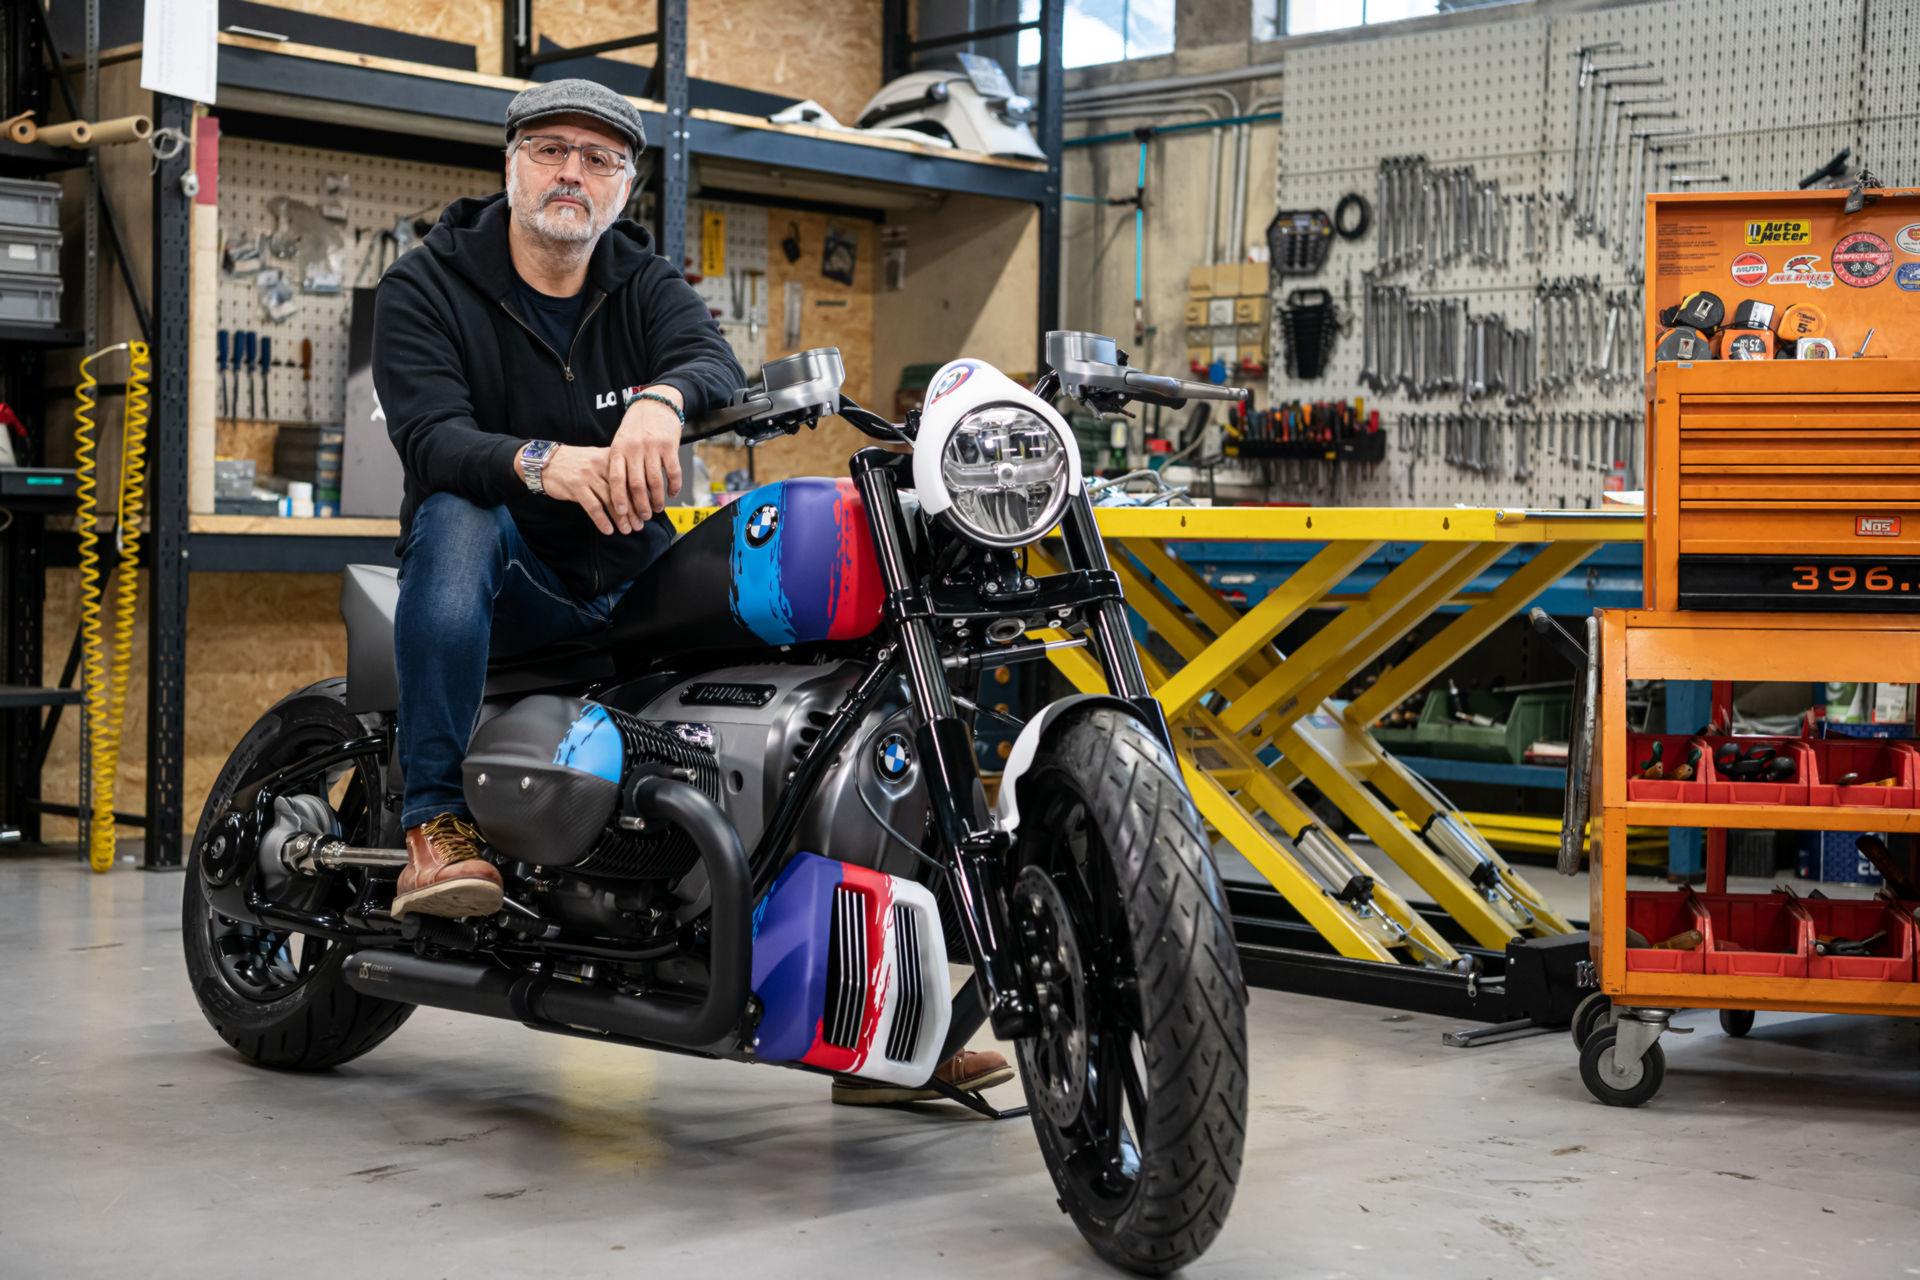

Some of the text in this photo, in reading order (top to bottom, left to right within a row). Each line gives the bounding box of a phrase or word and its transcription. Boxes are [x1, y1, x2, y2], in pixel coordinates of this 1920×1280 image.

[1764, 222, 1801, 232] Auto
[1760, 231, 1808, 244] Meter
[1864, 252, 1889, 260] CIRCLE
[1736, 265, 1763, 273] MUTH
[1770, 274, 1792, 282] ALL
[1792, 565, 1920, 591] 396.
